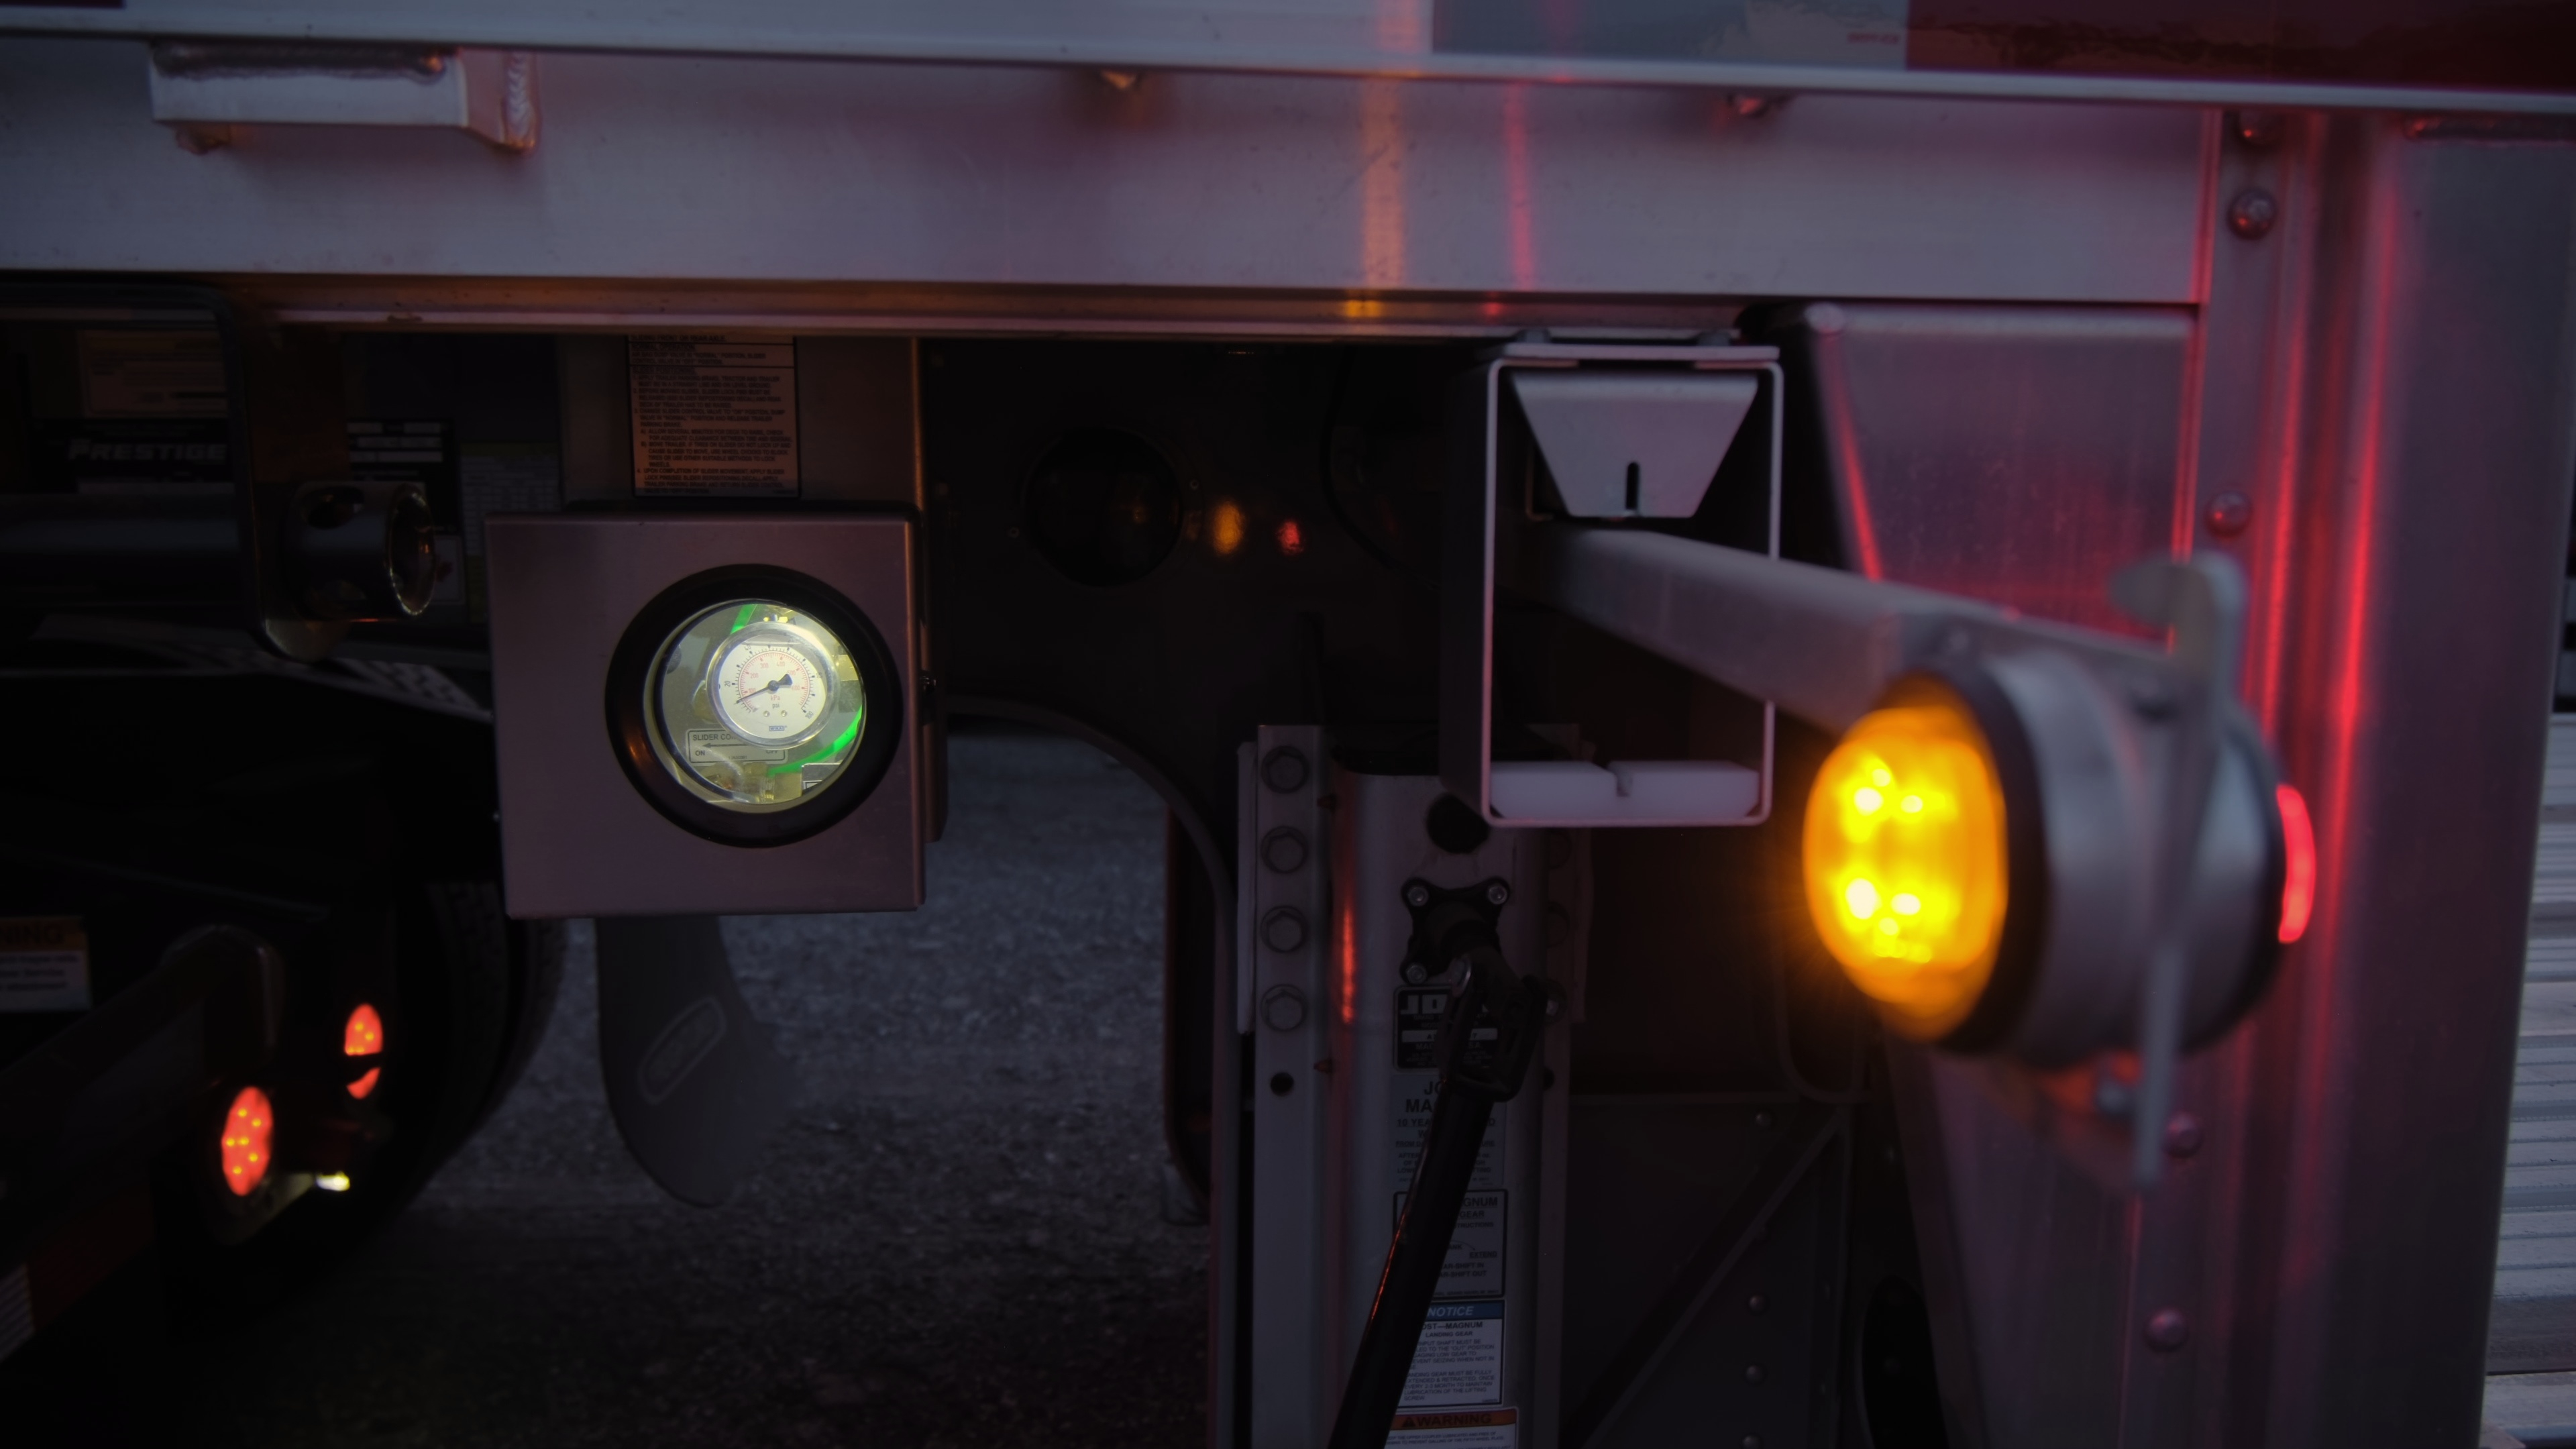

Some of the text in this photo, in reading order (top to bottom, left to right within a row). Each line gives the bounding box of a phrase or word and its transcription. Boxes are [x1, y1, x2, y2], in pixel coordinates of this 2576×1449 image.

[67, 438, 227, 462] PRESTIGE
[1401, 995, 1448, 1014] JO
[1405, 1099, 1433, 1113] MA
[1397, 1120, 1408, 1128] 10
[1463, 1197, 1498, 1207] GNUM
[1460, 1211, 1485, 1219] GEAR
[1469, 1251, 1498, 1259] EXTEND
[1427, 1307, 1474, 1317] NOTICE
[1417, 1413, 1492, 1427] WARNING
